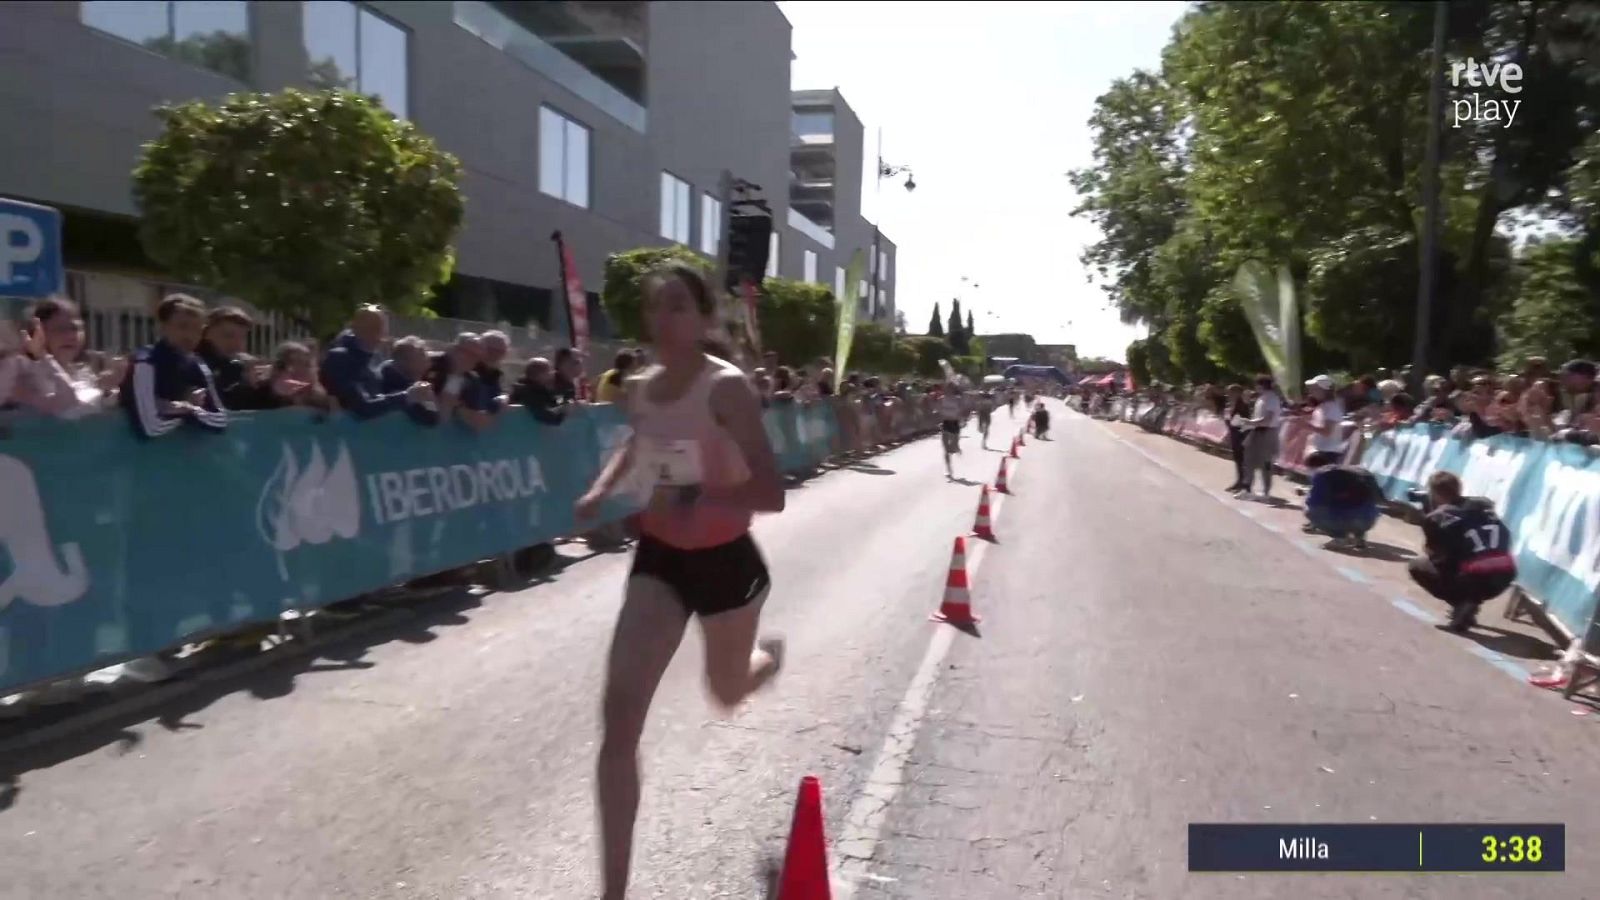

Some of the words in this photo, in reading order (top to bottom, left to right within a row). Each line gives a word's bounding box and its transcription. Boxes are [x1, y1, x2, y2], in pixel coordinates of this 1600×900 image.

[0, 213, 44, 285] P
[367, 455, 547, 525] IBERDROLA
[1464, 524, 1500, 552] 17
